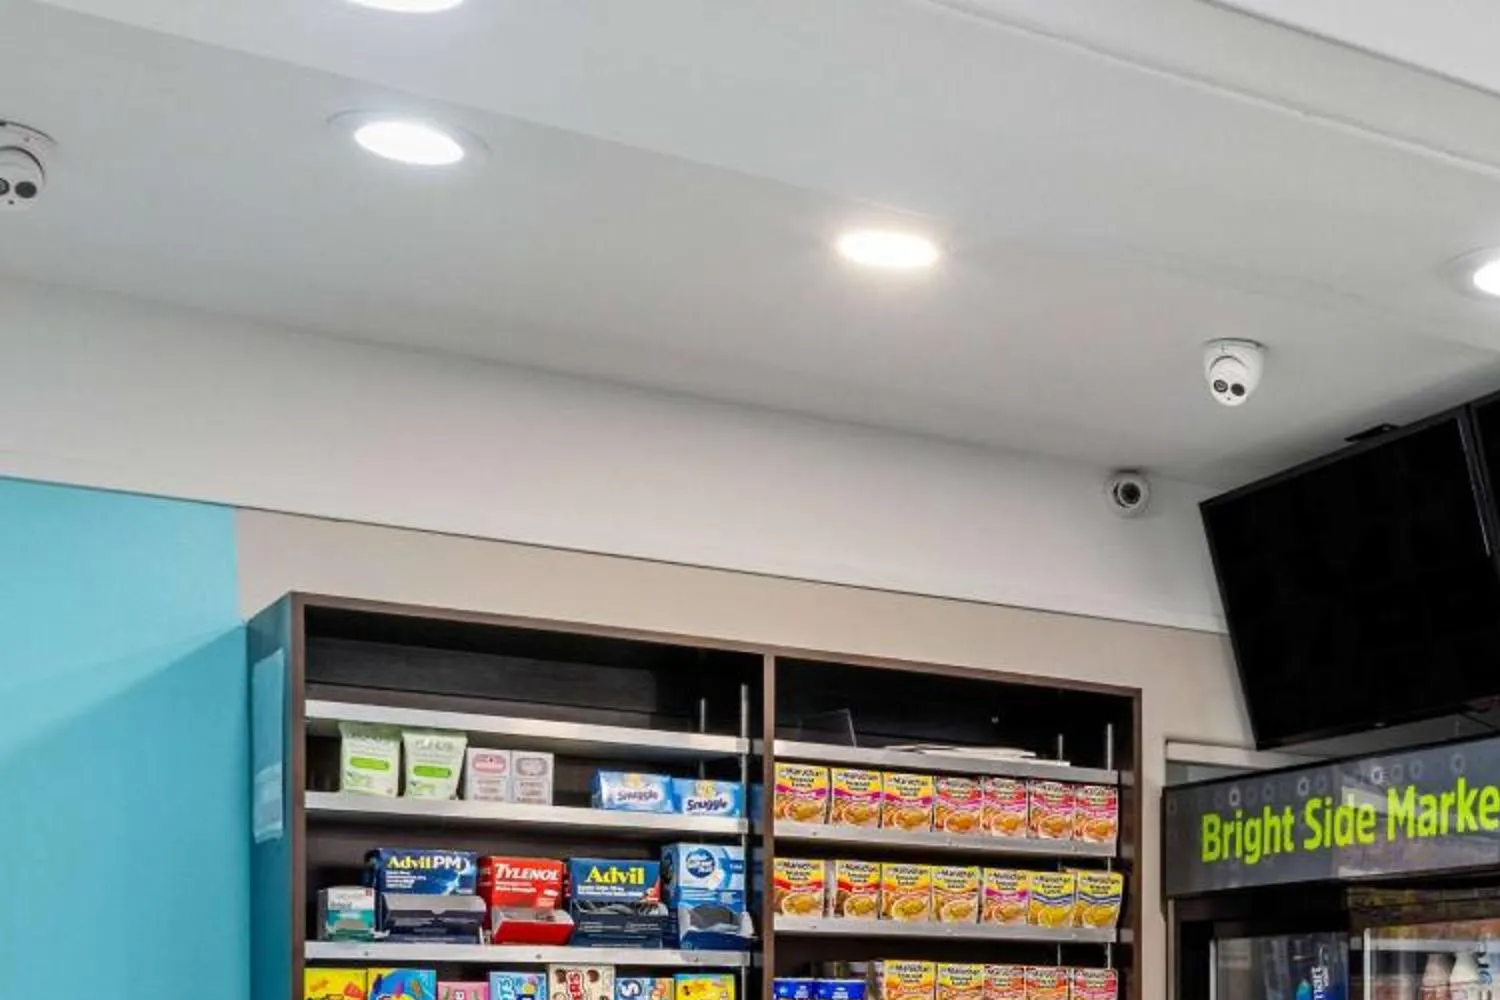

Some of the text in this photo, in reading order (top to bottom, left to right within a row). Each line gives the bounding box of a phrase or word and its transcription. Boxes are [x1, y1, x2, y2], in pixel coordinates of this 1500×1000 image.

[686, 798, 729, 812] Snuggle
[1201, 804, 1295, 865] Bright
[1304, 794, 1377, 850] Side
[387, 855, 461, 869] Advil PM
[495, 863, 558, 881] TYLENOL
[585, 865, 645, 885] Advil
